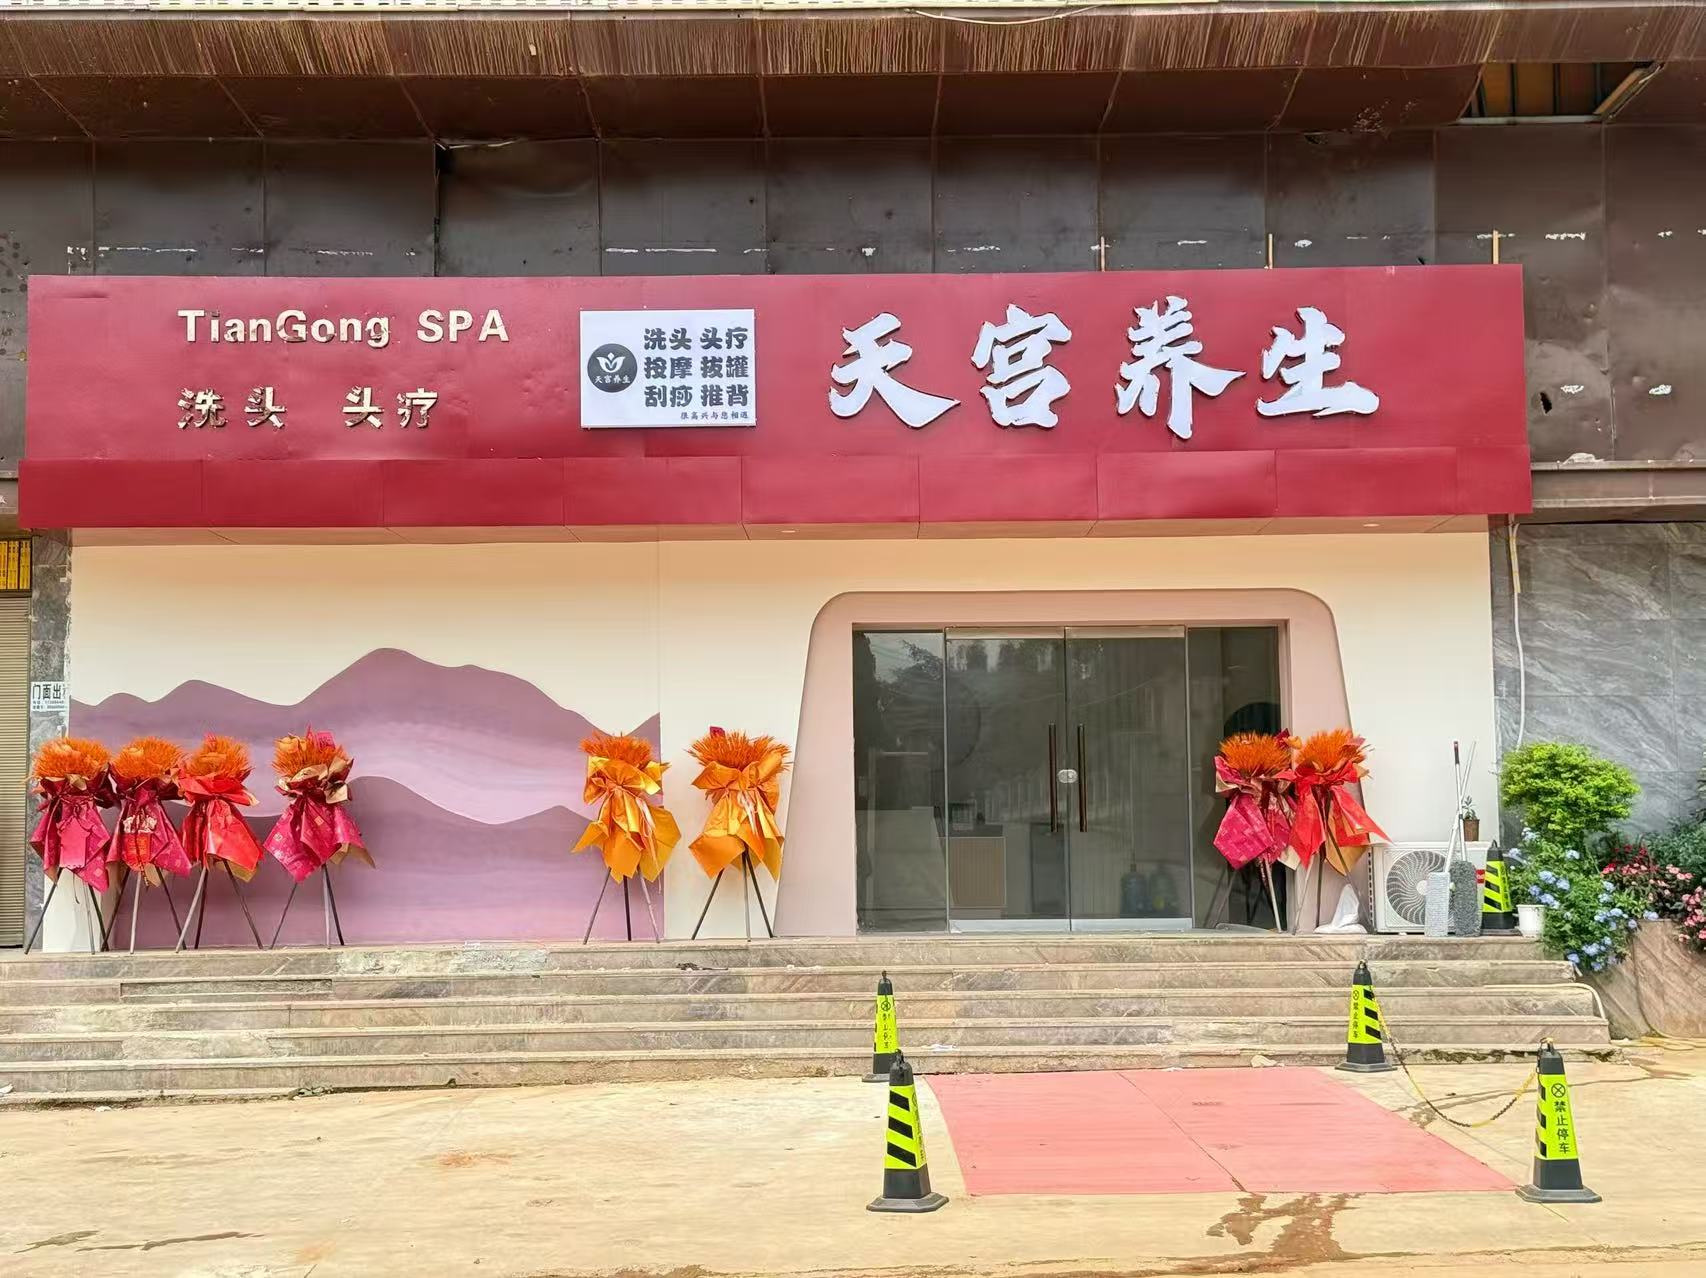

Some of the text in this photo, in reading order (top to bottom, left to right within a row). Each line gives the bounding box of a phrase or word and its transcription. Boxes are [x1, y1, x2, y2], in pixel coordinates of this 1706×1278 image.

[177, 309, 509, 348] TianGong SPA
[643, 326, 749, 351] 洗头 头疗
[643, 355, 749, 379] 按摩 拔罐
[829, 296, 1380, 440] 天宫养生
[177, 385, 439, 429] 洗头 头疗
[643, 384, 749, 408] 刮痧 推背
[1554, 1101, 1570, 1154] 禁止停车
